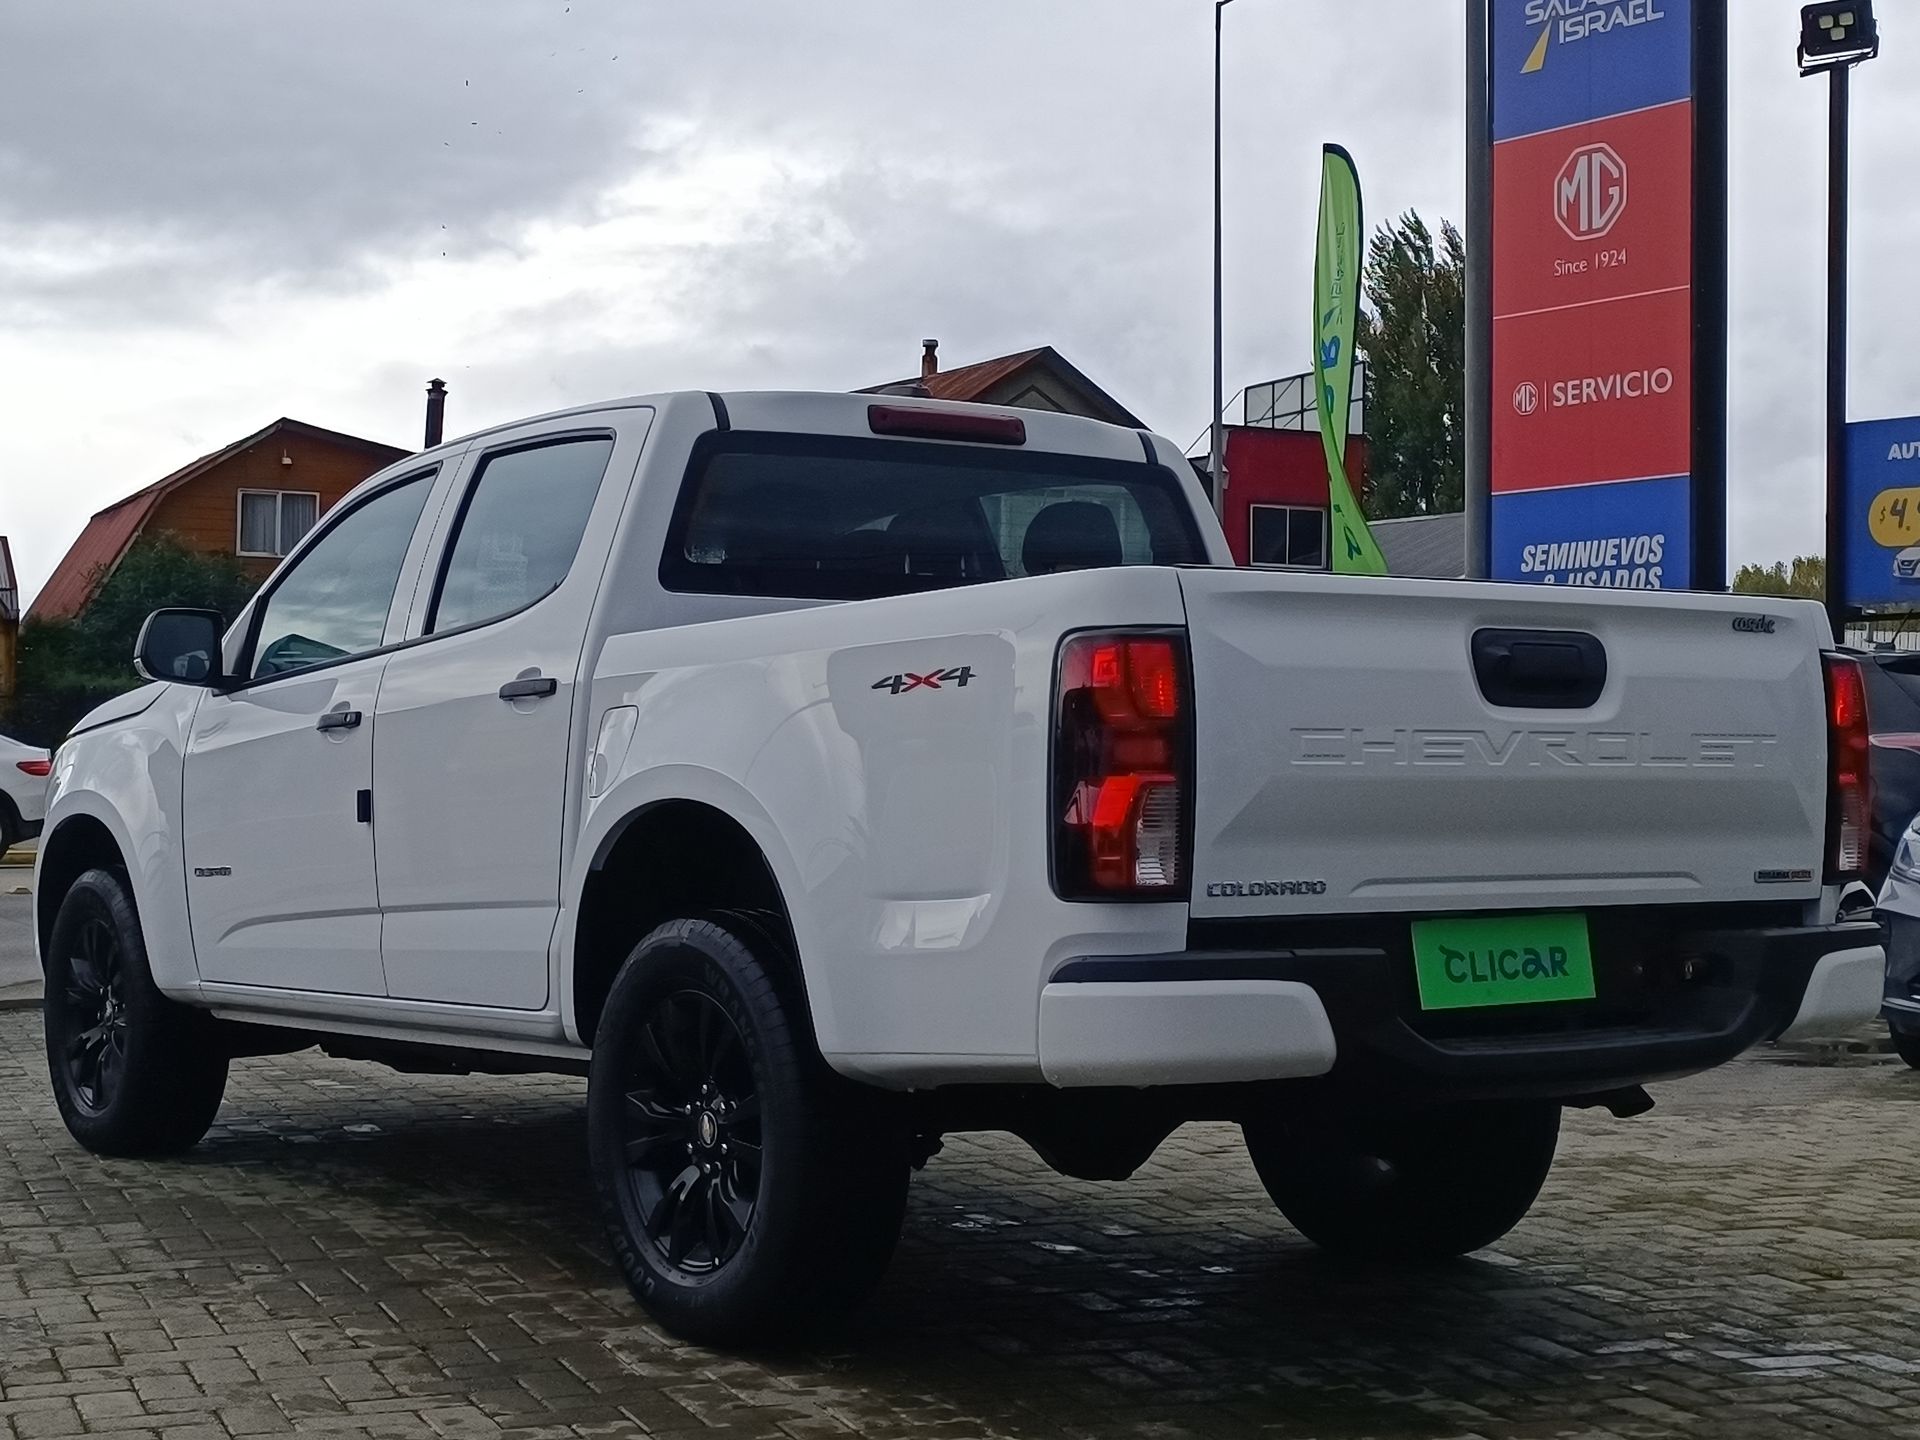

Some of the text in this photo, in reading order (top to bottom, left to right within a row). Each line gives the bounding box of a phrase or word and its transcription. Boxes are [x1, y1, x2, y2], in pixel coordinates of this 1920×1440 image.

[1560, 0, 1664, 44] ISRAEL
[1561, 151, 1620, 231] MG
[1554, 247, 1627, 276] Since 1924
[1515, 367, 1673, 412] MG SERVICIO
[1521, 534, 1665, 573] SEMINUEVOS
[1290, 728, 1777, 767] CHEVROLET
[1206, 880, 1326, 898] COLORADO
